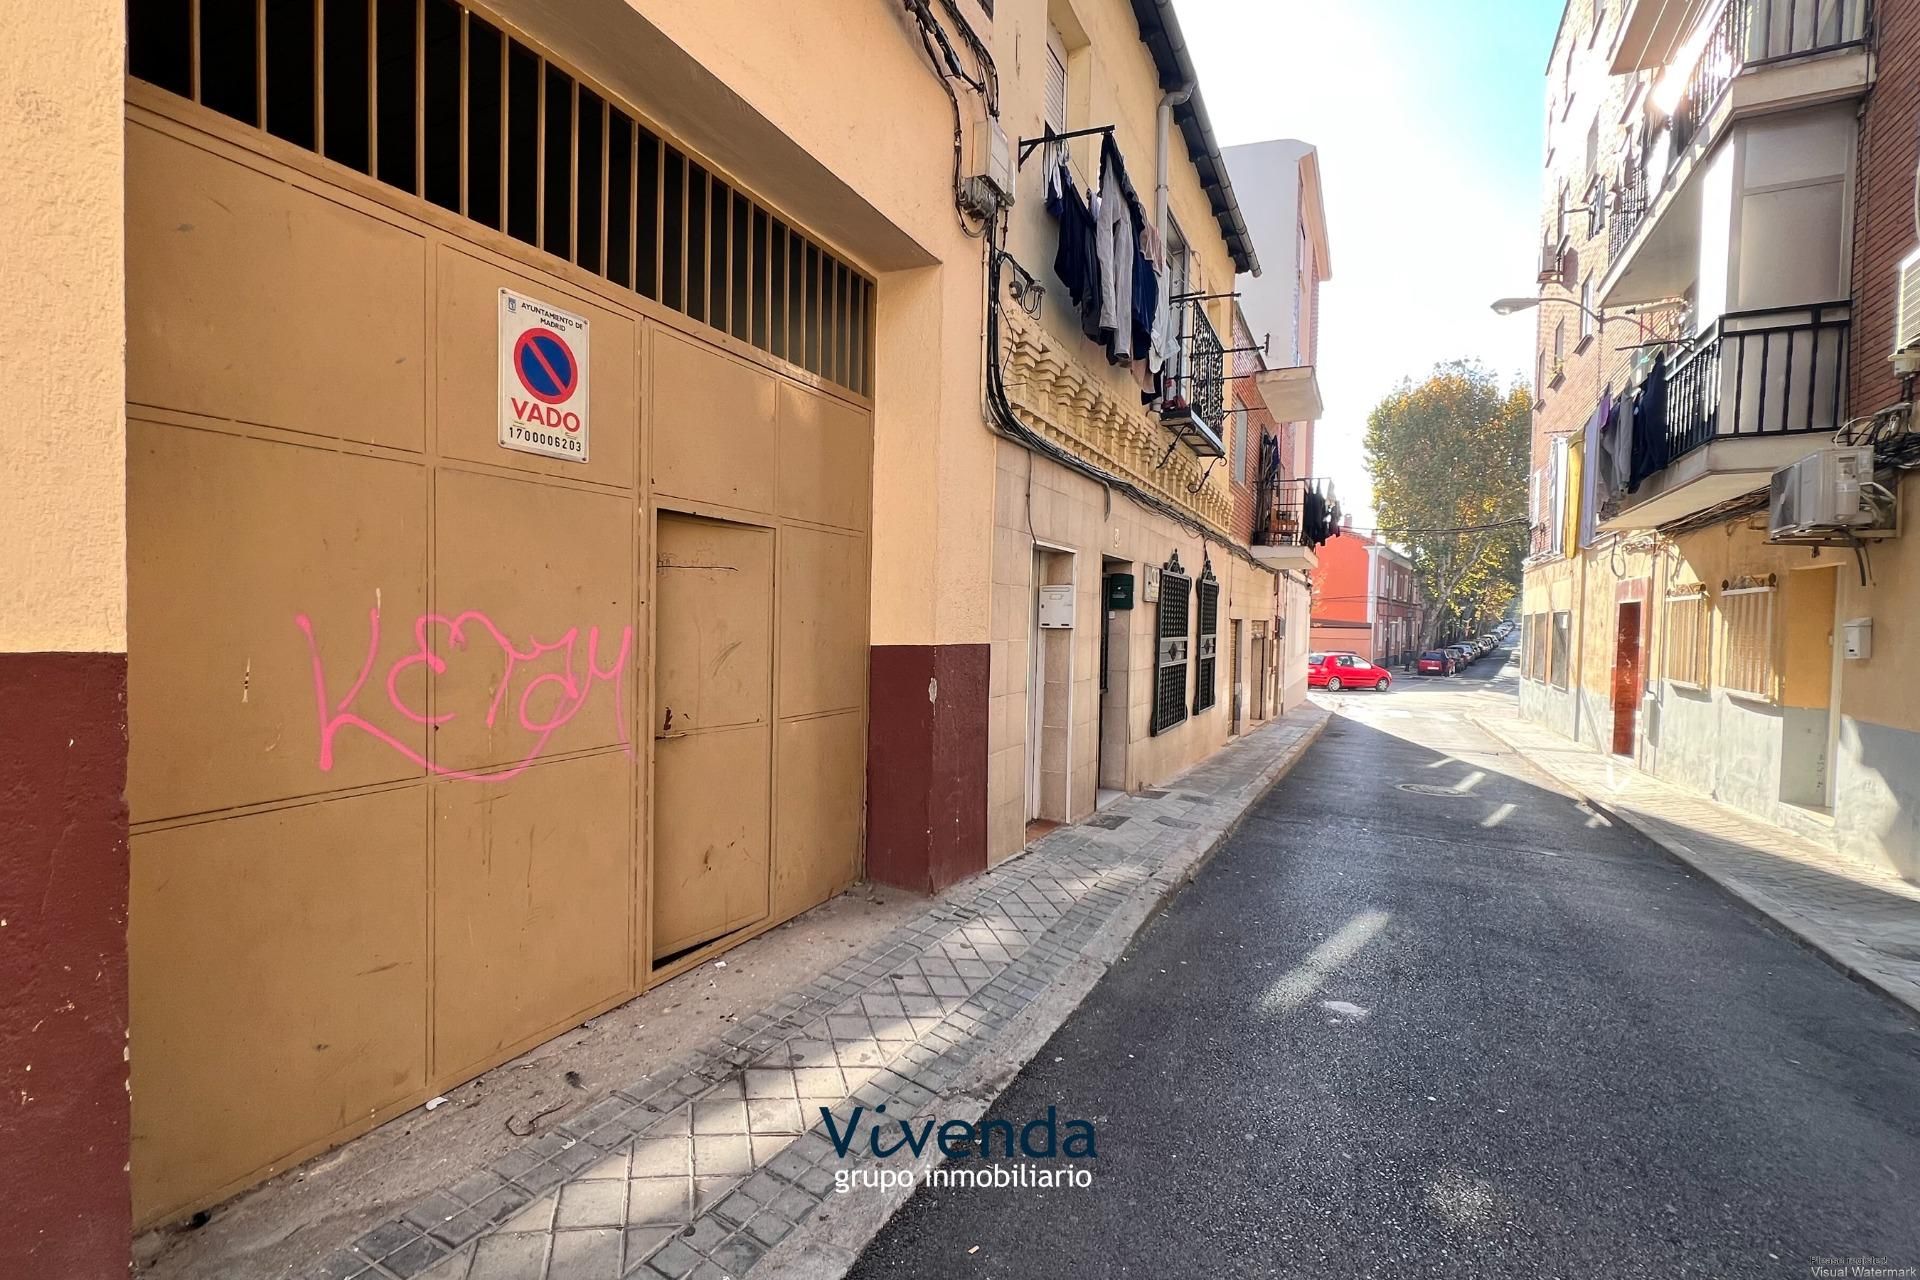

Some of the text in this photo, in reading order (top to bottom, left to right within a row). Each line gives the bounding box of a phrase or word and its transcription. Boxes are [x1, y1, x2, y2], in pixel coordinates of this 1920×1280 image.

[521, 302, 583, 330] AYUNTAMIENTO DE
[540, 317, 566, 332] MADRID
[511, 397, 580, 433] VADO
[509, 427, 582, 452] 1700006203
